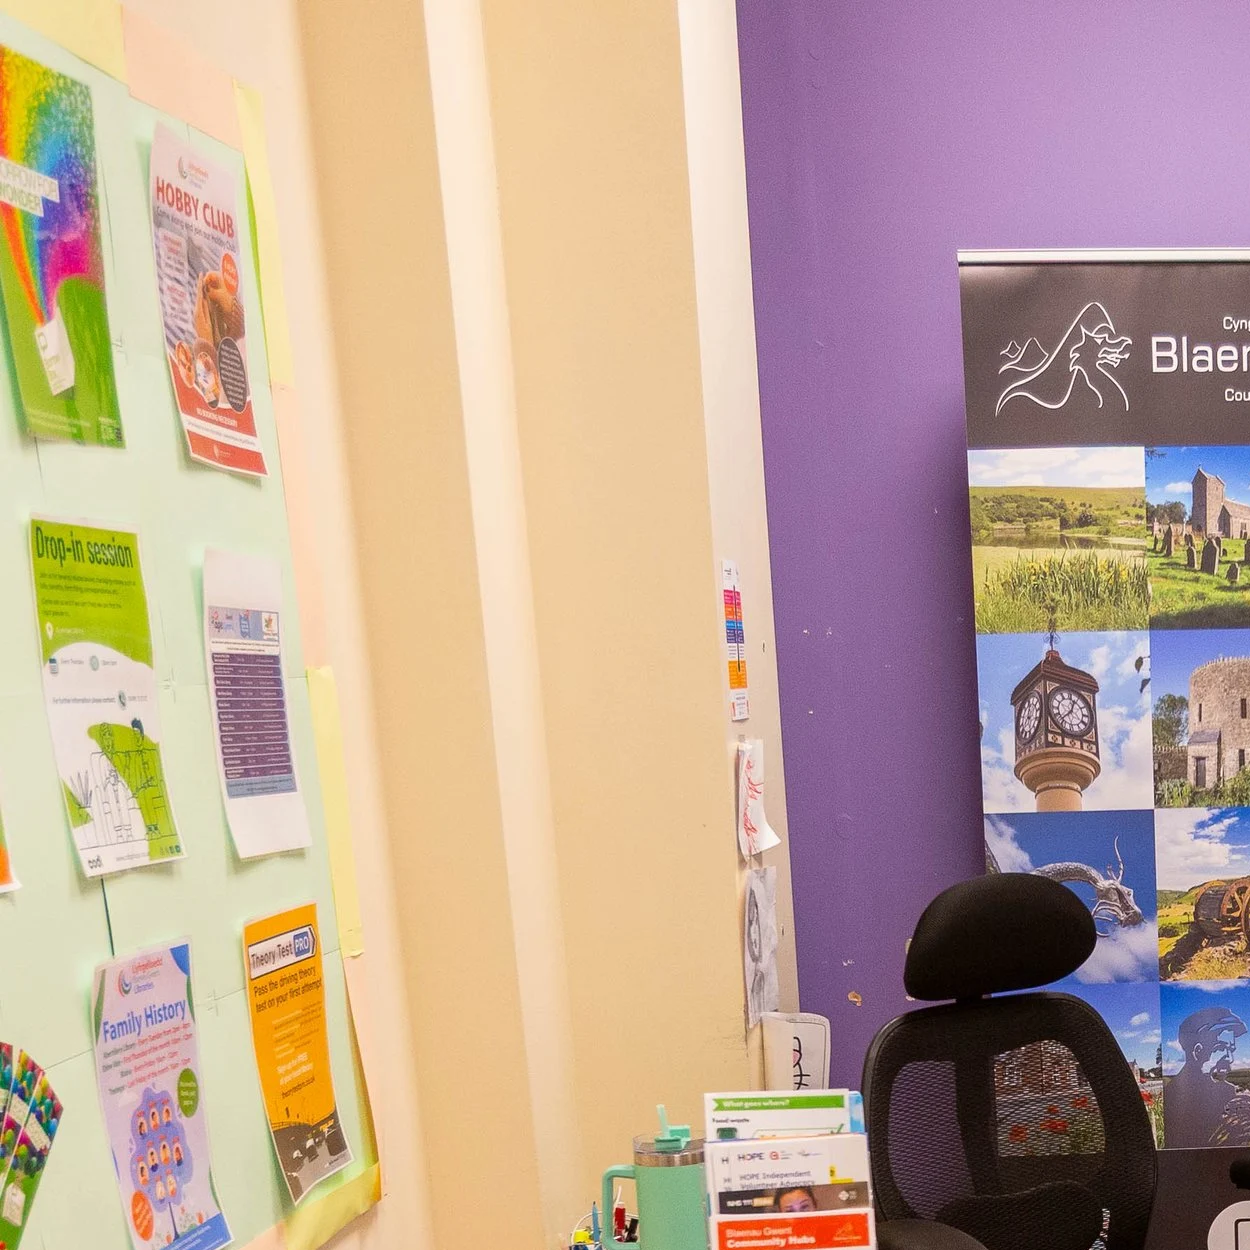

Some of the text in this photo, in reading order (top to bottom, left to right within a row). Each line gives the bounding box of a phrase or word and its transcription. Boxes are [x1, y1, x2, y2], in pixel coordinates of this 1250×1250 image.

[156, 176, 199, 220] HOBBY
[203, 202, 234, 238] CLUB
[36, 526, 133, 568] Drop-in session
[251, 941, 293, 969] Theory Test
[295, 936, 309, 953] PRO
[254, 984, 269, 997] Pass
[269, 980, 278, 992] the
[279, 972, 298, 988] driving
[103, 1000, 186, 1043] Family History
[762, 1171, 811, 1180] Independent
[726, 1227, 792, 1238] Blaenau Gwent
[727, 1236, 816, 1248] Community Hubs
